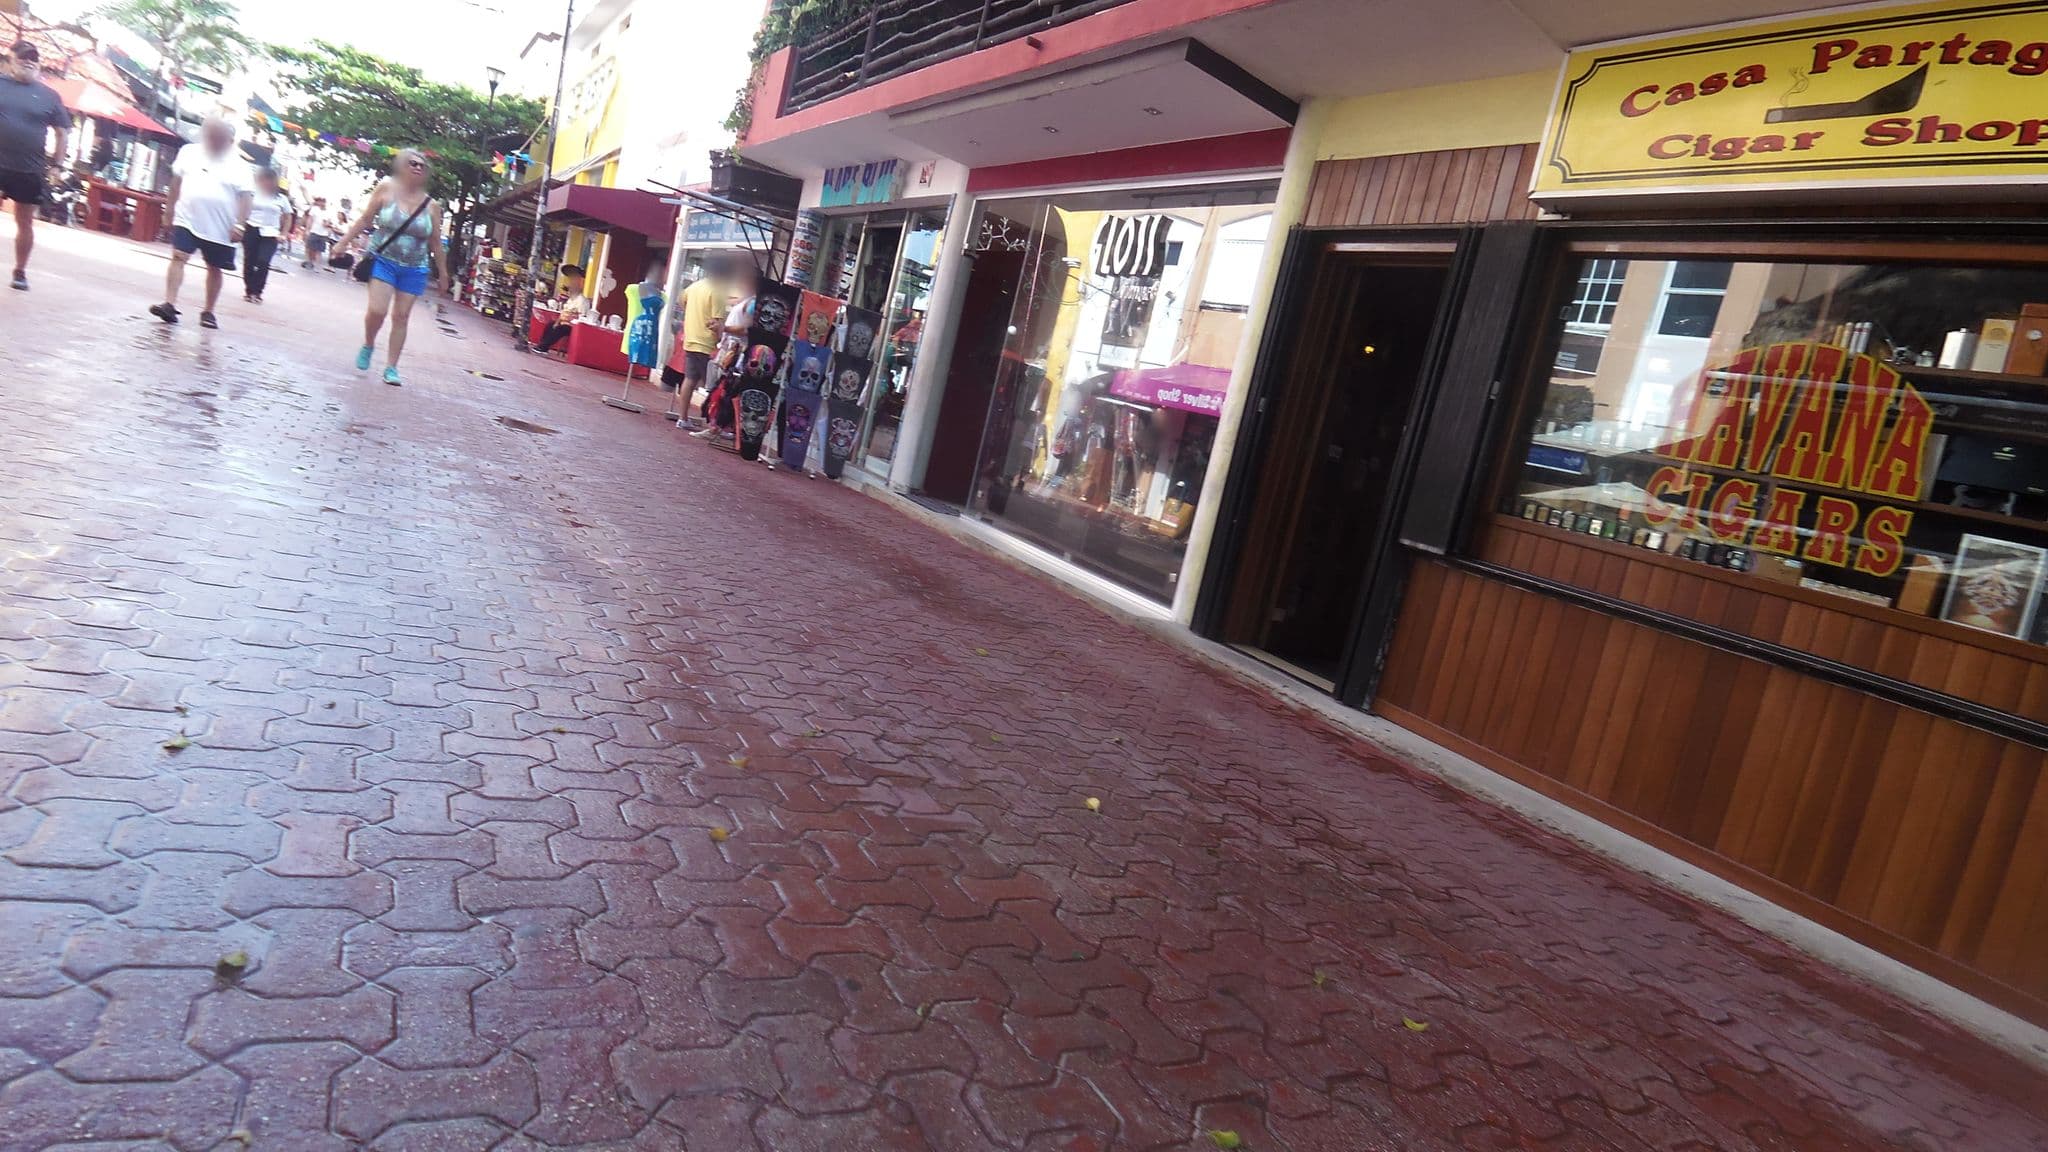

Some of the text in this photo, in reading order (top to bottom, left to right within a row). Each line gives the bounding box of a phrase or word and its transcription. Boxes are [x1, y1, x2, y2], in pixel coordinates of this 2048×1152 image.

[1619, 34, 2048, 118] Casa Partag
[1647, 115, 2048, 160] Cigar Shop
[1644, 466, 1914, 578] CIGARS
